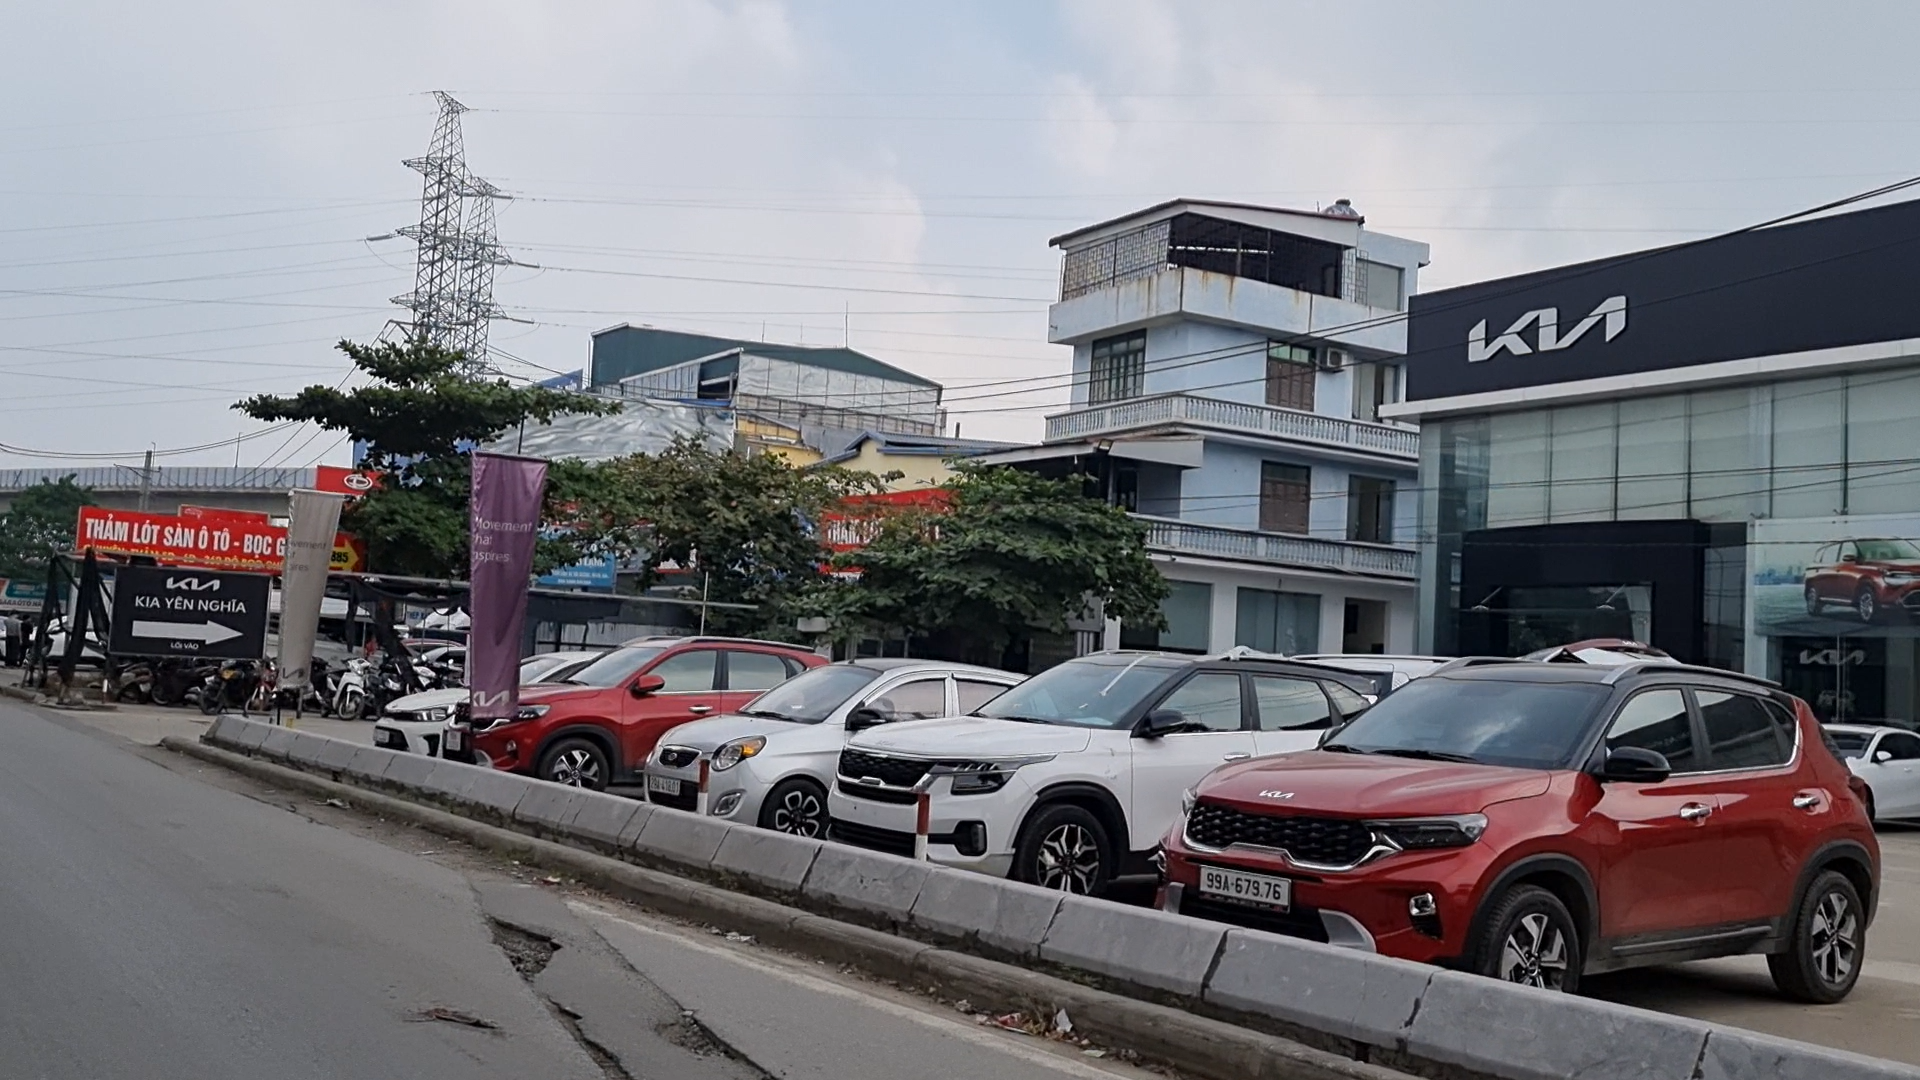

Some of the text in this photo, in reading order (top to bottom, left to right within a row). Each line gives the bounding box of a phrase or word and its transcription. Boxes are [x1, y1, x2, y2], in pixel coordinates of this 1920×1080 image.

[1468, 295, 1626, 362] KIA
[86, 514, 129, 542] THẢM
[132, 520, 160, 545] LÓT
[163, 523, 194, 548] SÀN
[198, 526, 208, 549] Ô
[213, 528, 230, 551] TÔ
[244, 534, 272, 559] BỌC
[474, 533, 493, 545] hat
[474, 551, 510, 563] nspires
[166, 577, 220, 591] KIA
[135, 595, 246, 614] KIA YÊN NGHĨA
[1206, 872, 1282, 900] 99A-679.76
